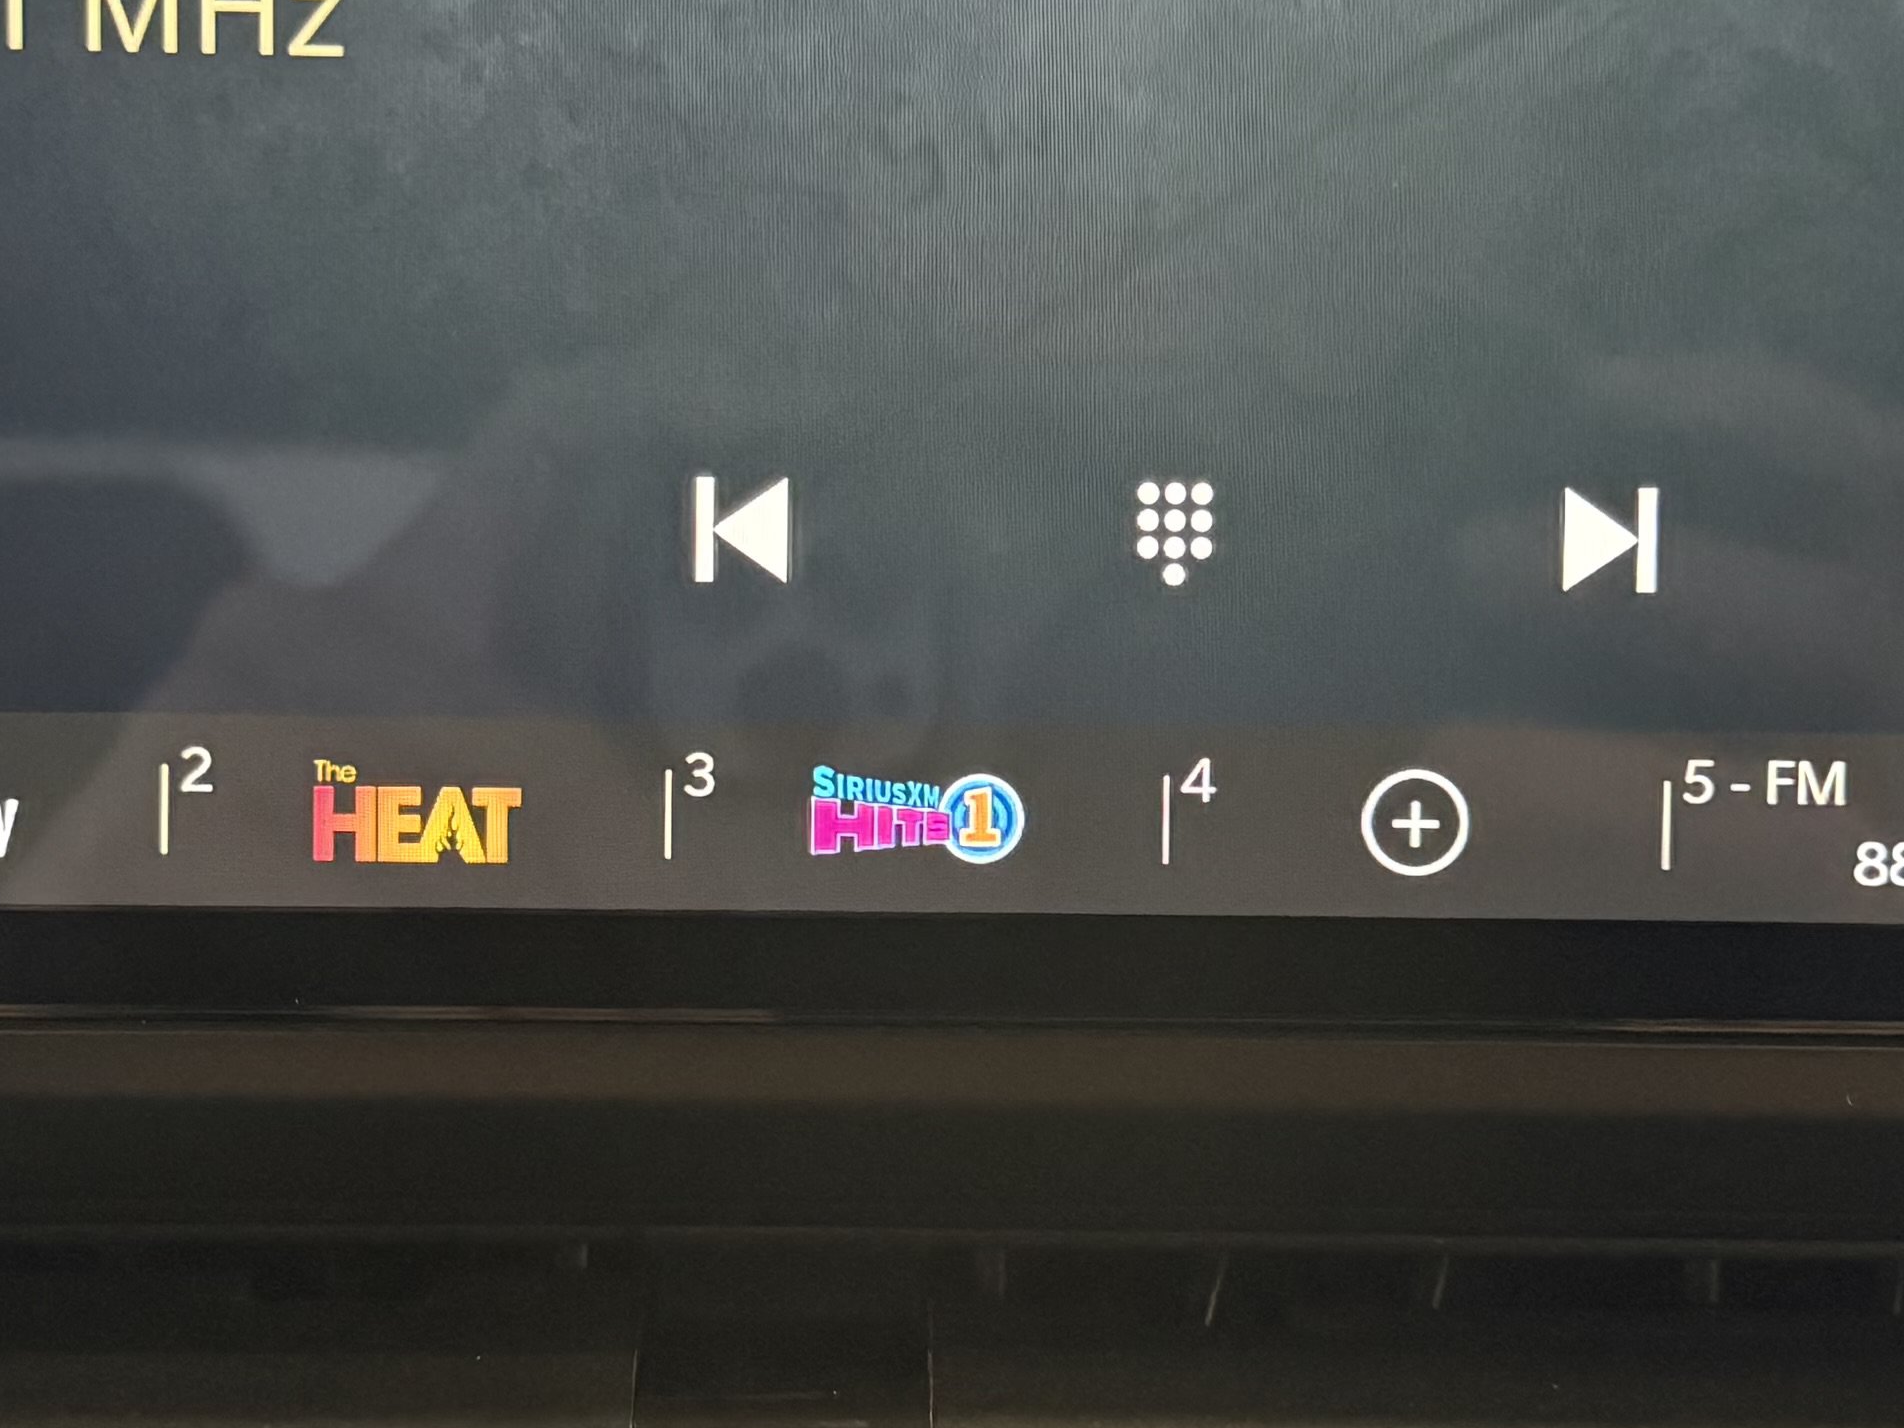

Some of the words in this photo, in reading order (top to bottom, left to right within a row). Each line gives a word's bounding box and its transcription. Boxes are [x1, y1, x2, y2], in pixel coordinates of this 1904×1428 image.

[179, 747, 214, 794] 2
[313, 759, 357, 783] The
[683, 752, 715, 798] 3
[1179, 757, 1217, 804] 4
[1682, 759, 1715, 807] 5
[1765, 759, 1849, 807] FM
[312, 785, 523, 864] HEAT
[810, 796, 952, 855] HITS
[959, 785, 1002, 847] 1
